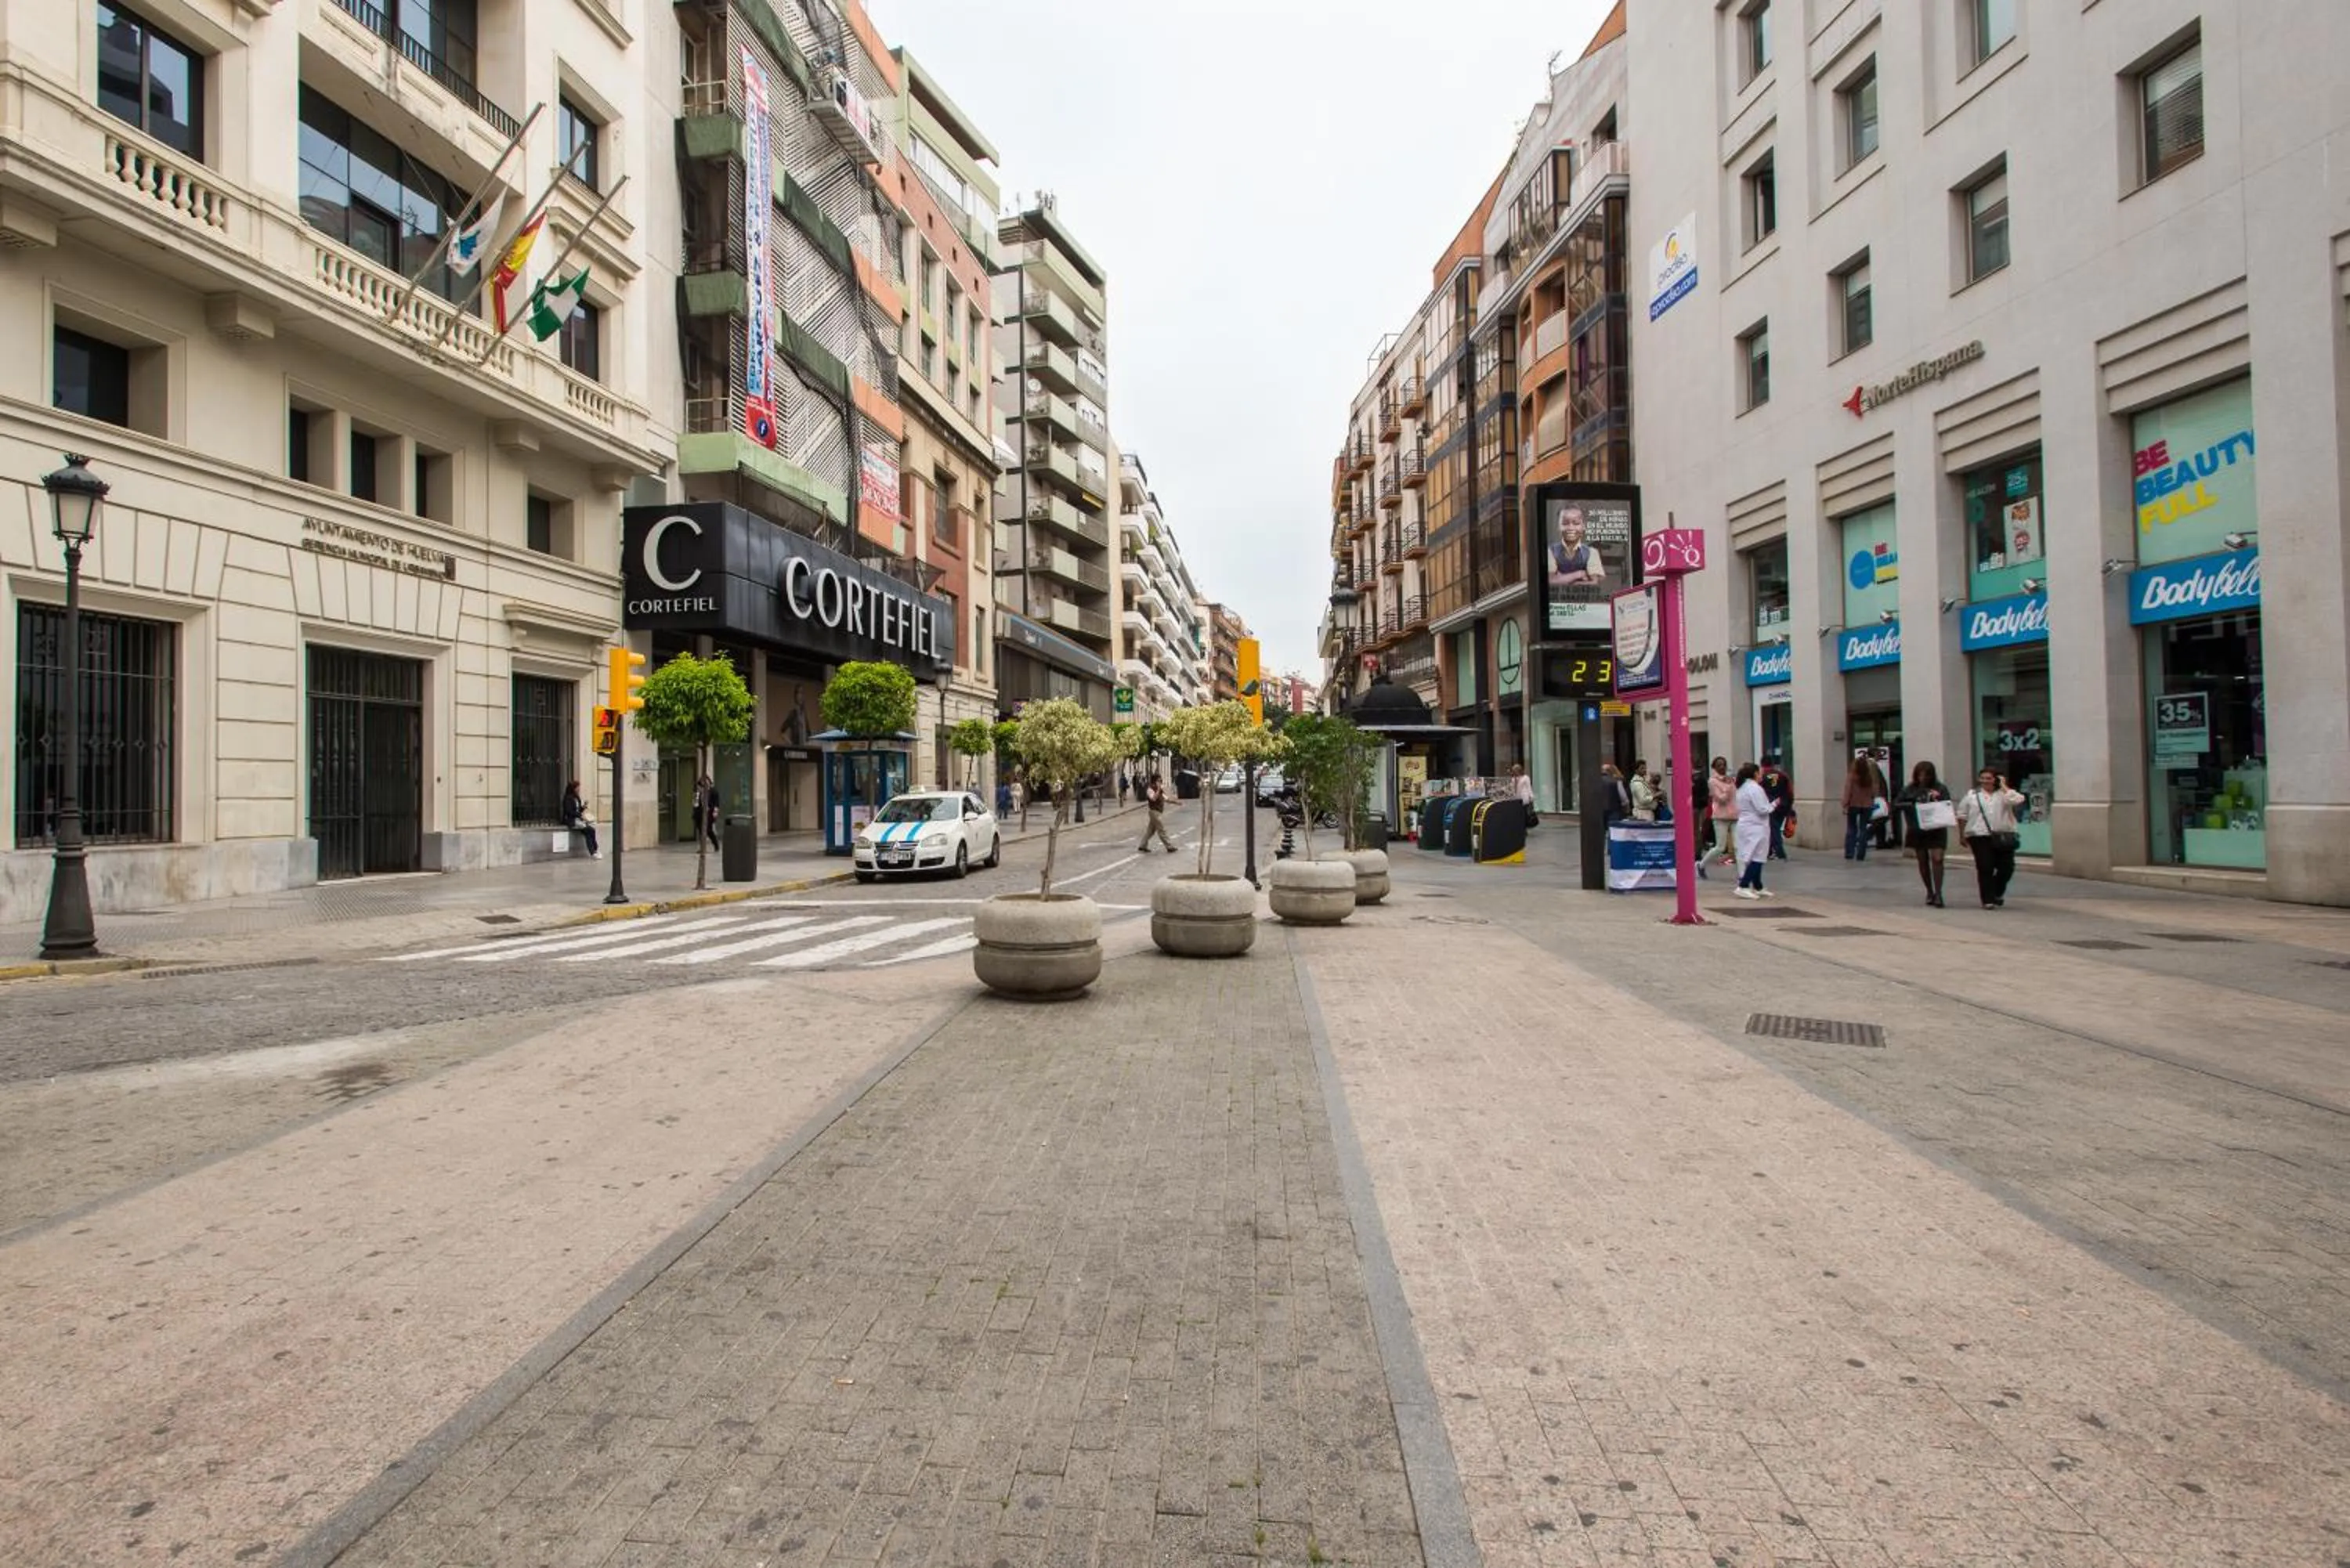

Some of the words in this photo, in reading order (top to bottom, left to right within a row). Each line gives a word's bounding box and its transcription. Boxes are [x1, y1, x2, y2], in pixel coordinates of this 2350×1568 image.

[2134, 439, 2169, 477] BE
[2135, 429, 2254, 505] BEAUTY
[2138, 481, 2219, 535] FULL
[301, 516, 389, 551] AYUNTAMIENTO
[392, 538, 404, 556] DE
[407, 543, 445, 564] HUELVA
[629, 596, 719, 615] CORTEFIEL
[786, 555, 941, 659] CORTEFIEL
[1969, 599, 2049, 640] Bodybel
[1999, 728, 2040, 751] 3x2
